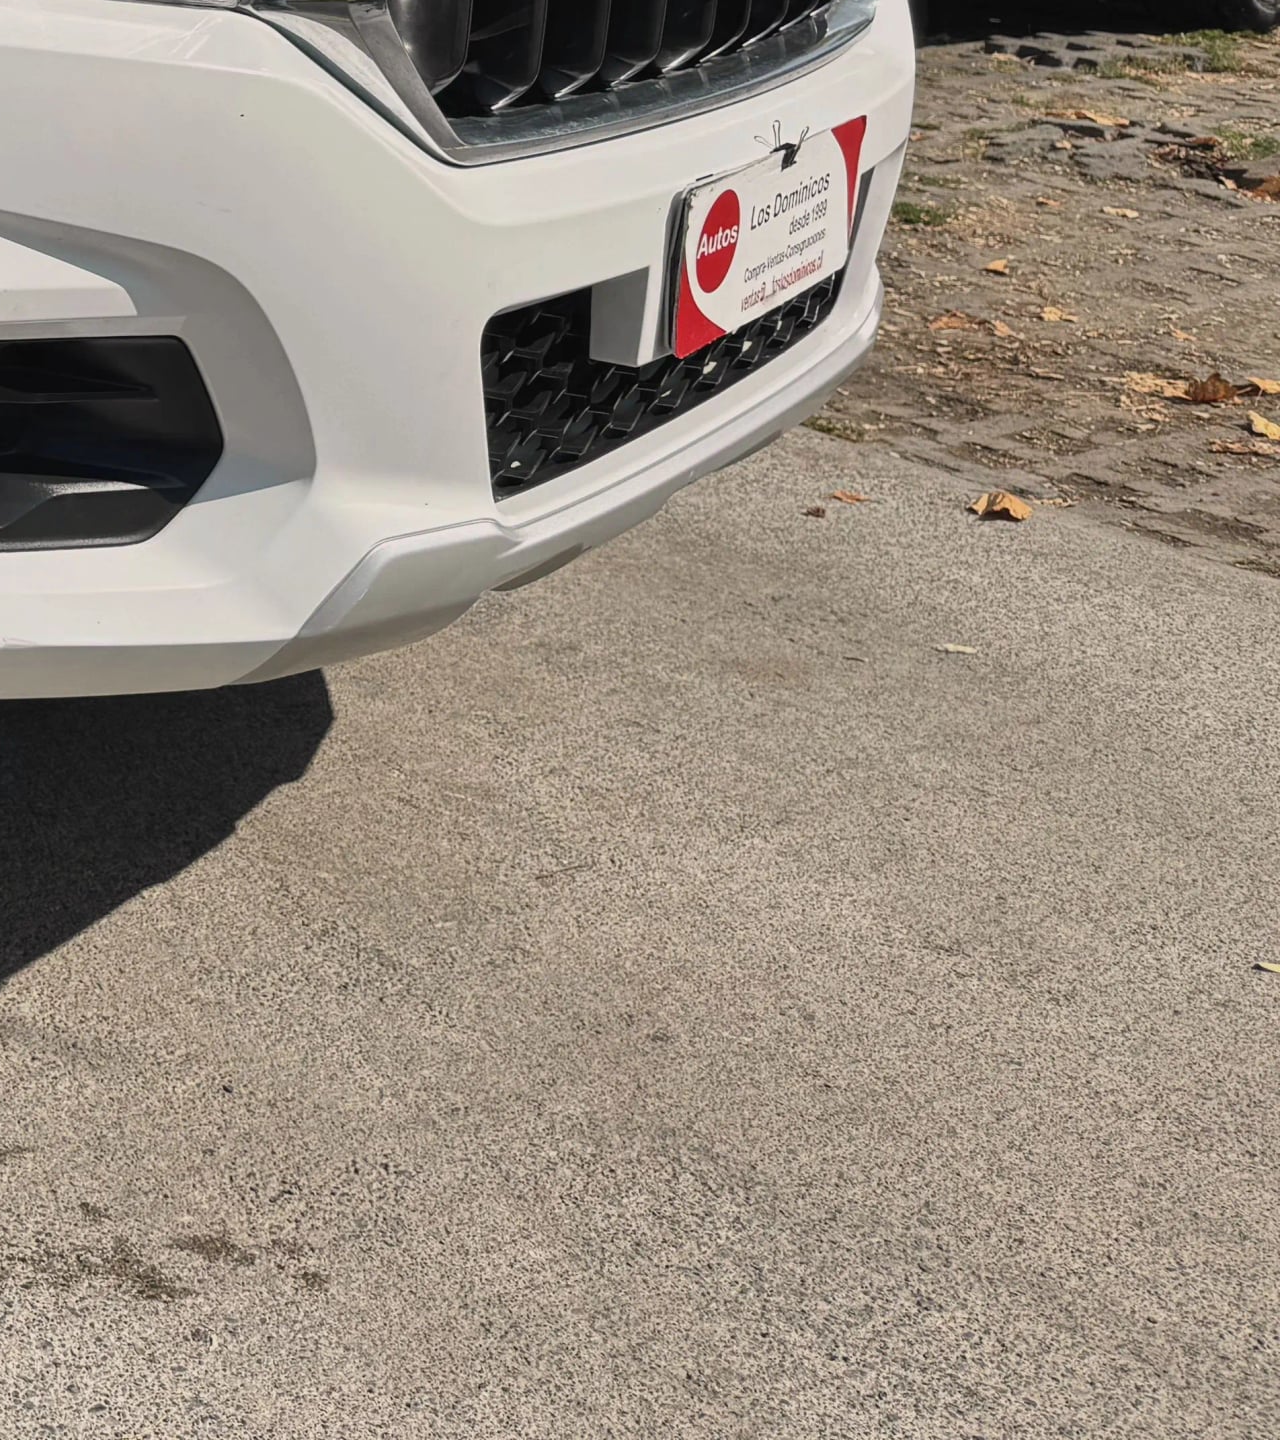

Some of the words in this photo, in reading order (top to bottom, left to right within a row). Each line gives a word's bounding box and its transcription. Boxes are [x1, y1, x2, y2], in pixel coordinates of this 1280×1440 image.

[750, 204, 771, 231] Los
[773, 172, 831, 219] Dominicos
[788, 209, 811, 236] desde
[697, 224, 738, 260] Autos
